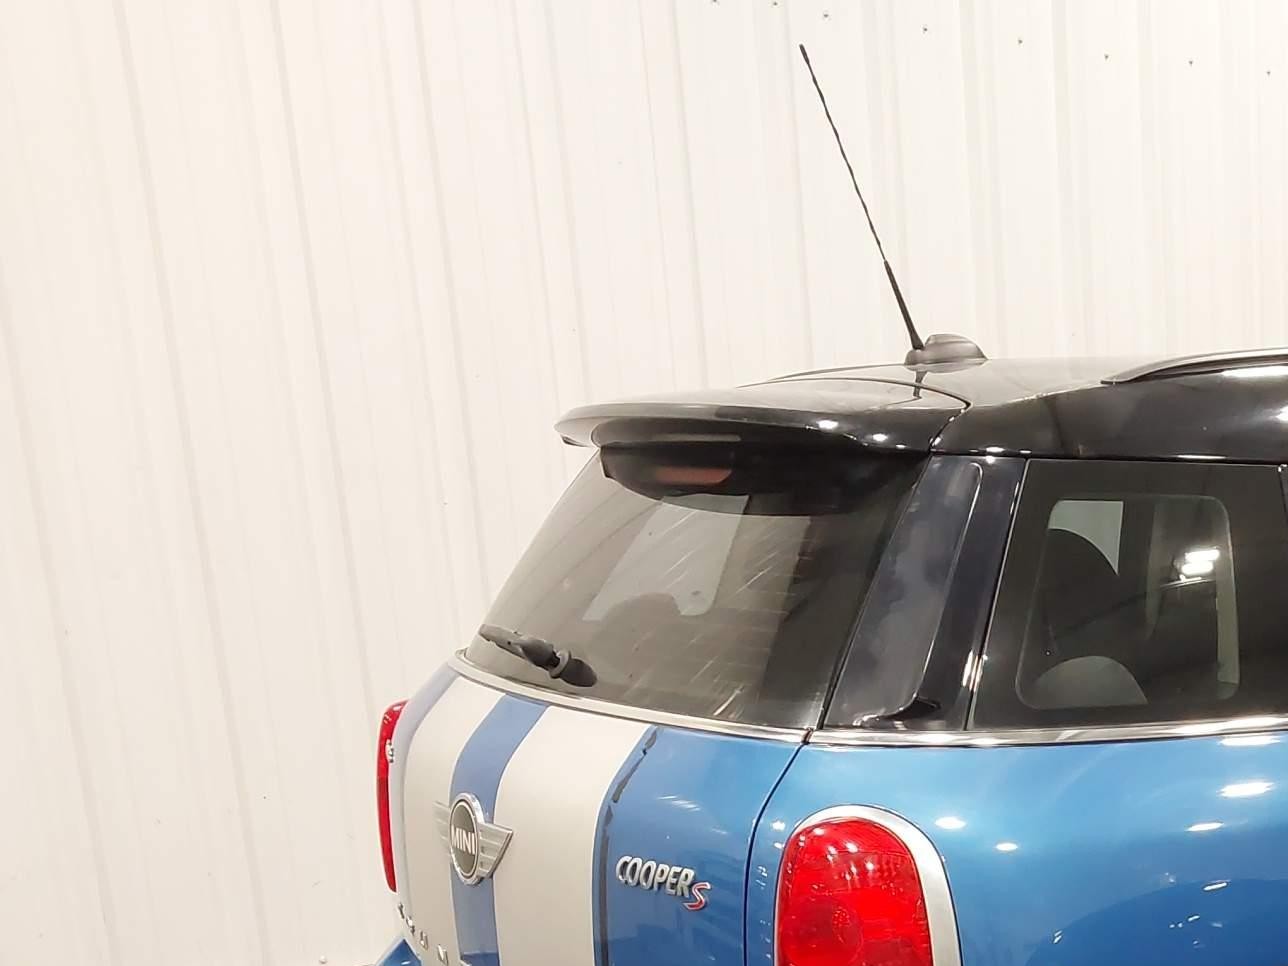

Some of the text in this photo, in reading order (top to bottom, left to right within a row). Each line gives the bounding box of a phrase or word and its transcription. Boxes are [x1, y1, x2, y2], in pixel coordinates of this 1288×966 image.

[450, 824, 477, 856] MINI
[615, 855, 712, 911] COOPER S
